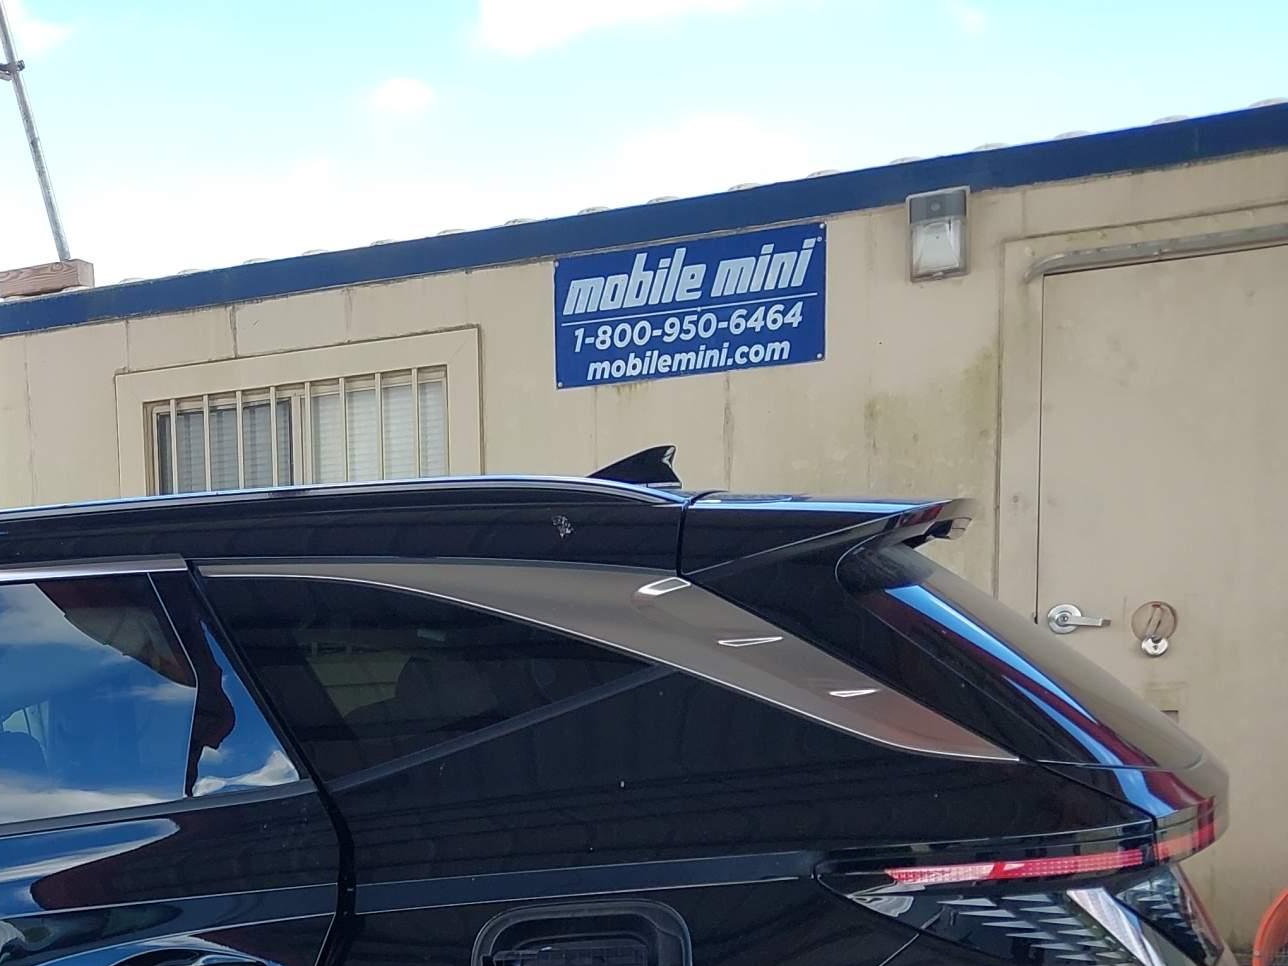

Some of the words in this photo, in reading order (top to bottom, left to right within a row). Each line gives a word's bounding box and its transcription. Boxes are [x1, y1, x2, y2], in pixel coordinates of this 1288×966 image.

[562, 247, 706, 316] mobile
[711, 237, 817, 297] mini
[573, 301, 803, 352] 1-800-950-6464
[586, 340, 790, 380] mobilemini.com
